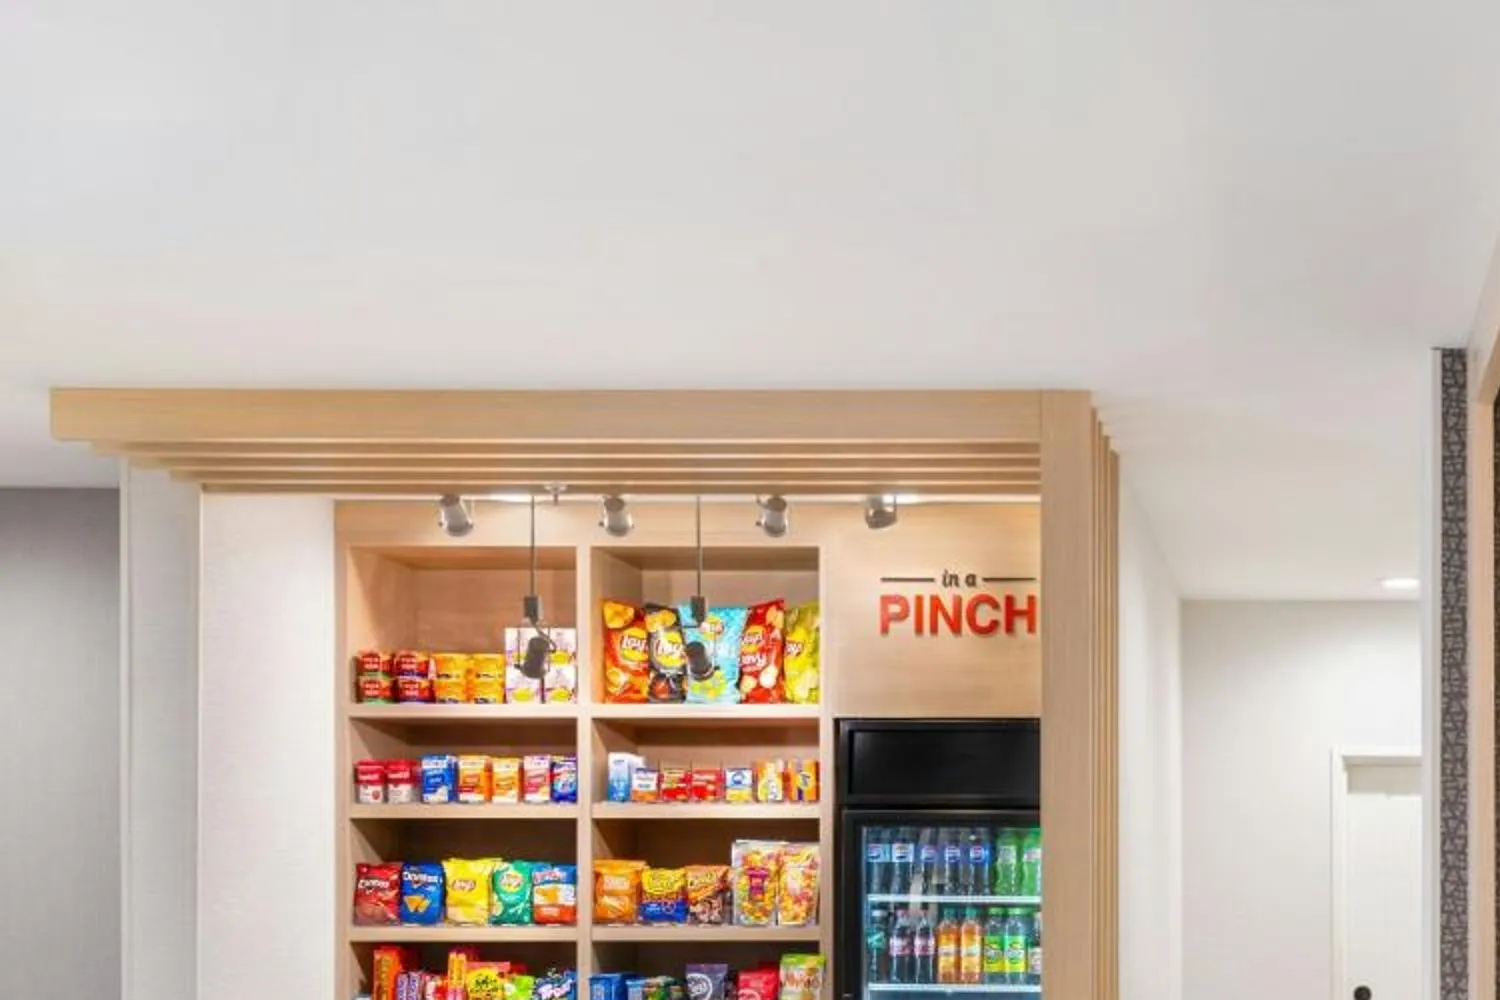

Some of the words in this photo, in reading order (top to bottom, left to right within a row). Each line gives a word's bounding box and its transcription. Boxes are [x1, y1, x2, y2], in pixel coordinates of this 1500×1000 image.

[942, 570, 960, 588] in
[965, 573, 978, 588] a
[879, 593, 1037, 636] PINCH
